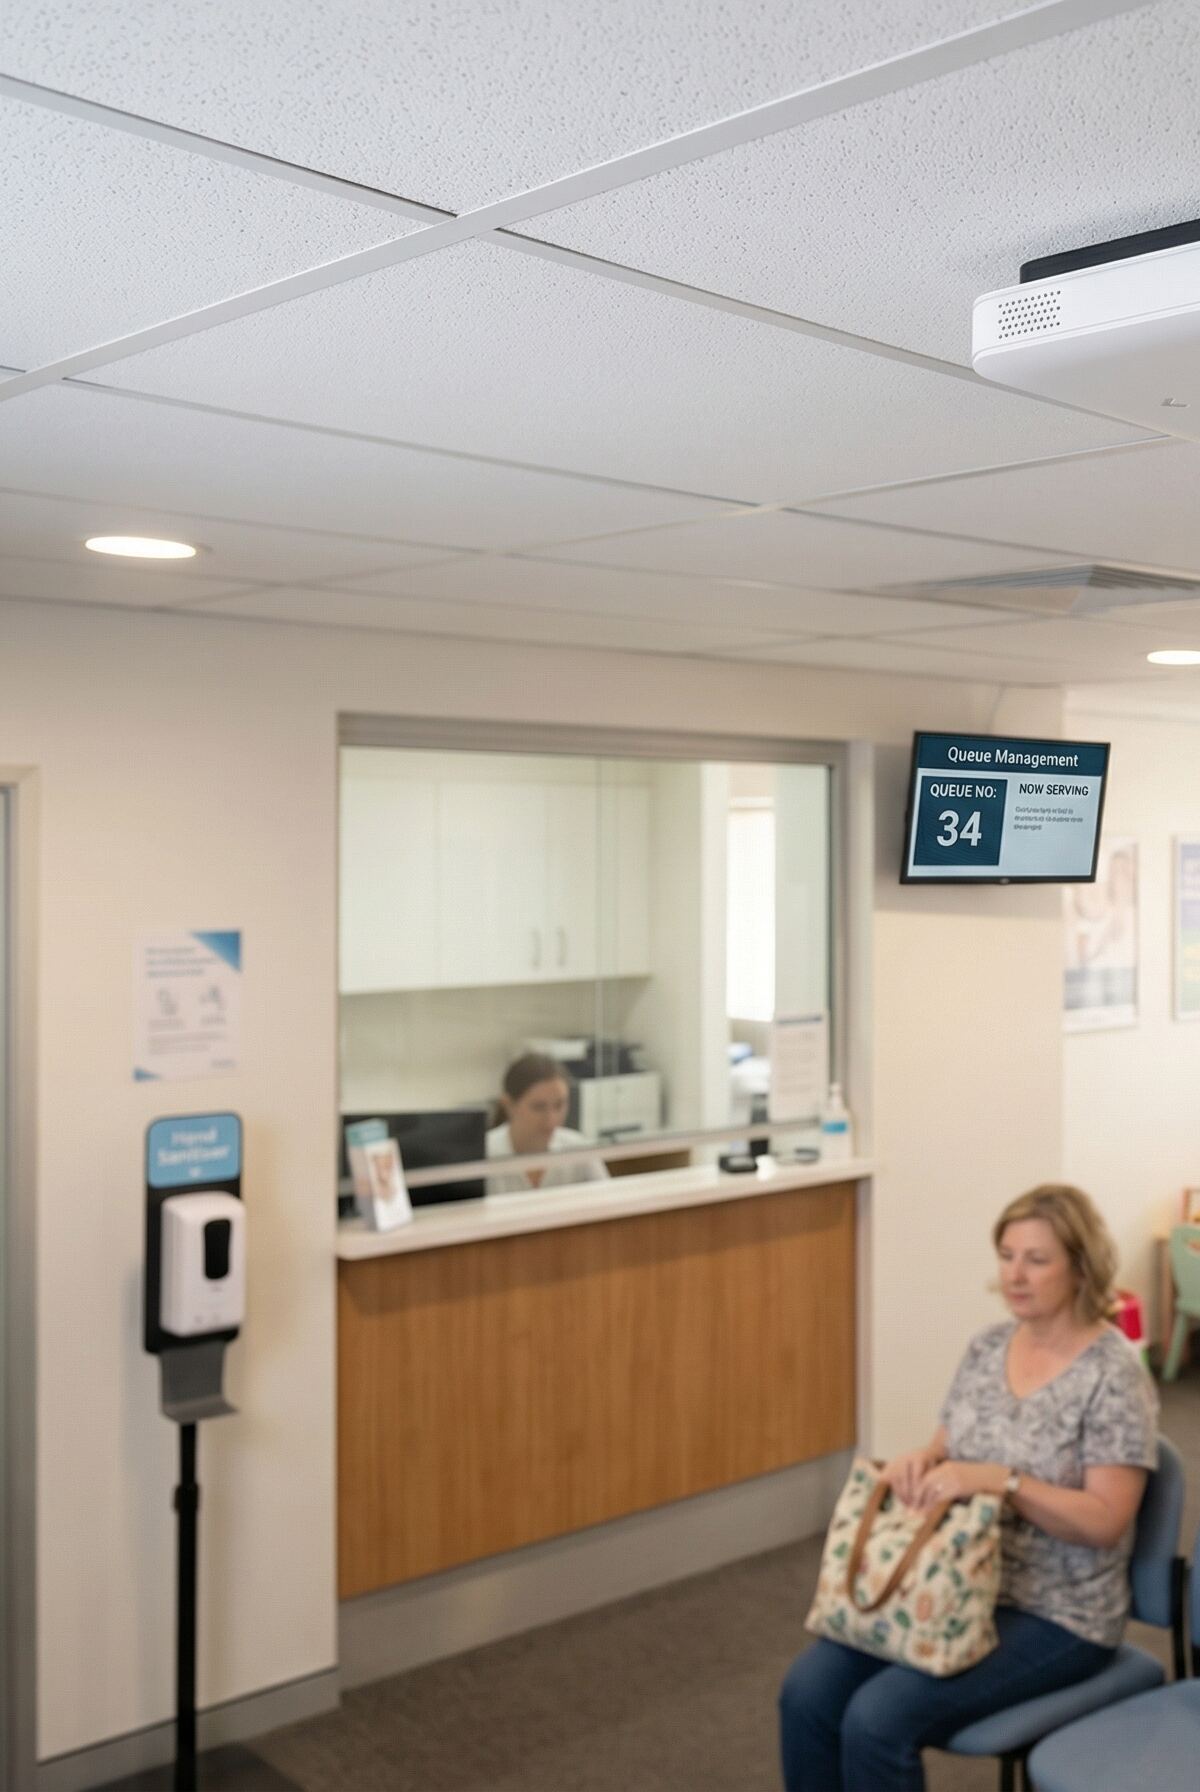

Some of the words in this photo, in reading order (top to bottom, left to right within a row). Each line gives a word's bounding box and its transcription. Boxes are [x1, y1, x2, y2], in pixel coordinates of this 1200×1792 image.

[948, 746, 992, 763] Queue
[995, 749, 1079, 768] Management
[930, 783, 973, 798] QUEUE
[975, 785, 997, 798] NO:
[1019, 783, 1044, 795] NOW
[1046, 784, 1089, 797] SERVING
[936, 810, 982, 847] 34
